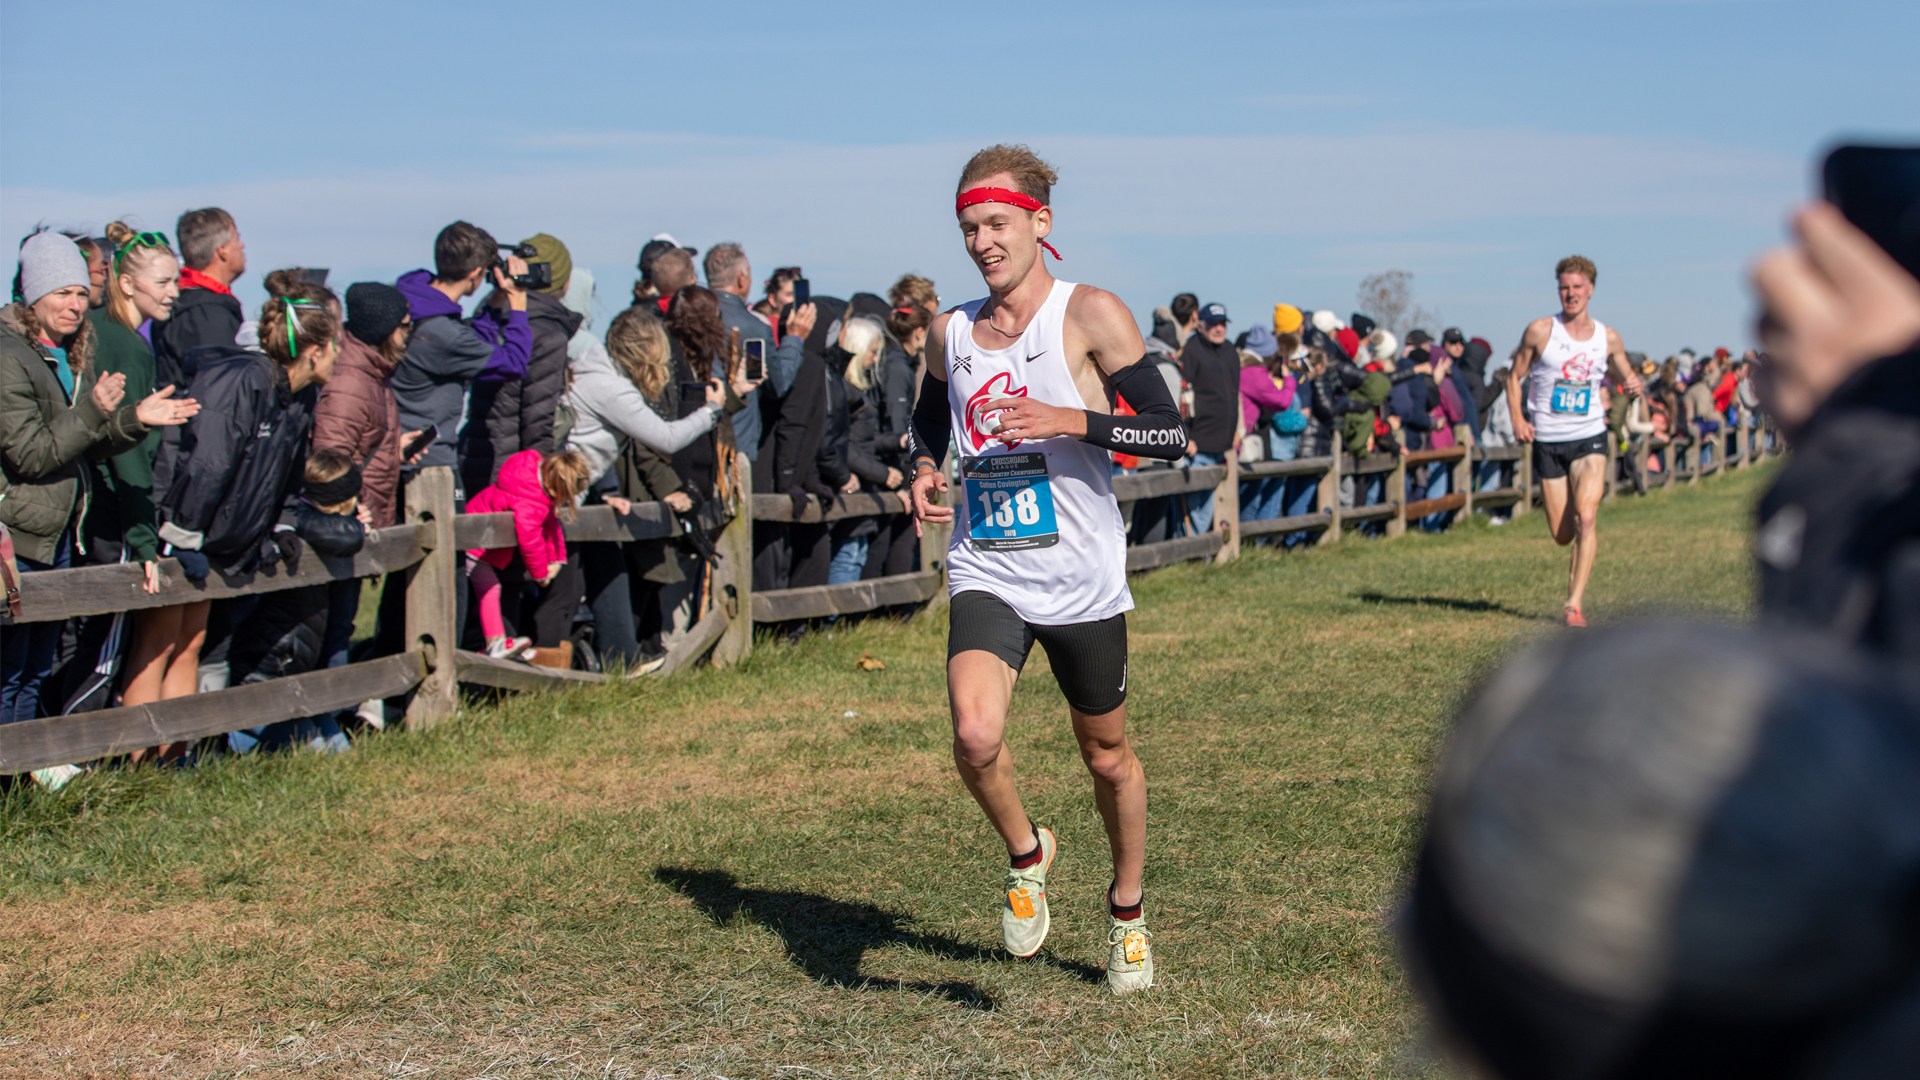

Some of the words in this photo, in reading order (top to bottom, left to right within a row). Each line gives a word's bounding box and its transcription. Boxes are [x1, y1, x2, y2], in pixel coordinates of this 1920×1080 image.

[1559, 392, 1586, 409] 154
[1110, 424, 1187, 448] saucony
[990, 455, 1029, 466] CROSSROADS
[1010, 468, 1045, 476] CHAMPIONSHIP
[997, 479, 1030, 489] Covington
[978, 487, 1040, 528] 138
